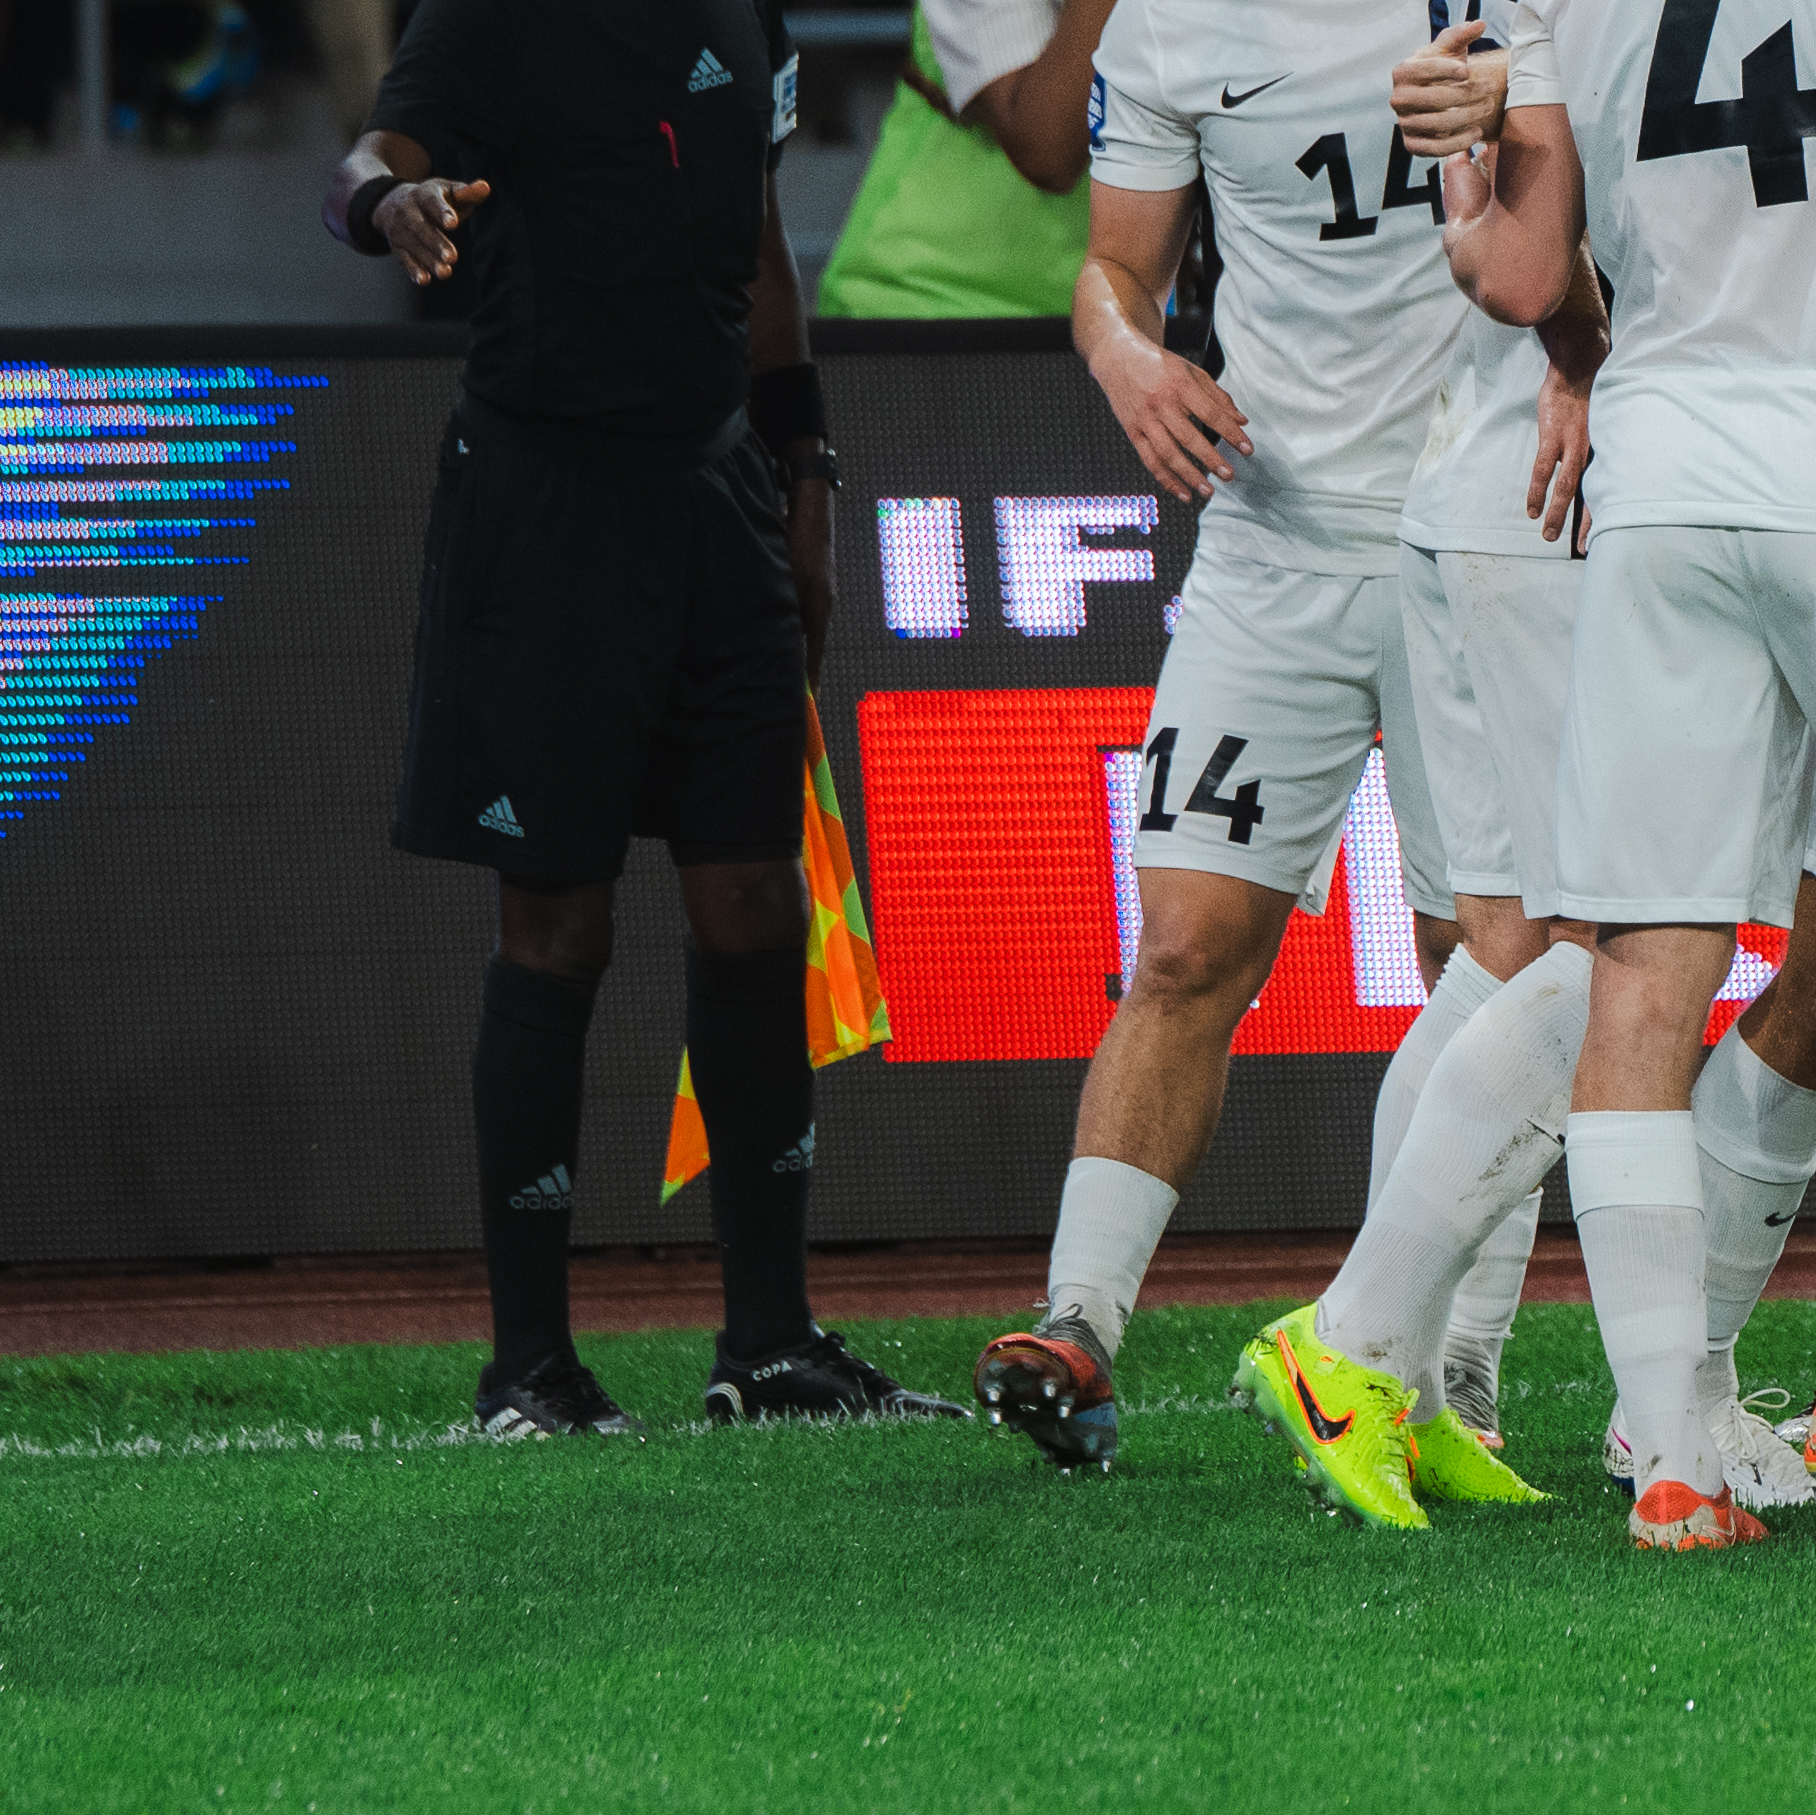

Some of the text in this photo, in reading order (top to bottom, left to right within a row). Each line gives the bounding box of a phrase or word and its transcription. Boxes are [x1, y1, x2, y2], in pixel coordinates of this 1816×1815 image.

[688, 70, 733, 93] adidas
[1295, 122, 1447, 242] 14
[1139, 727, 1265, 845] 14
[479, 813, 525, 838] adidas
[752, 1359, 792, 1382] COPA
